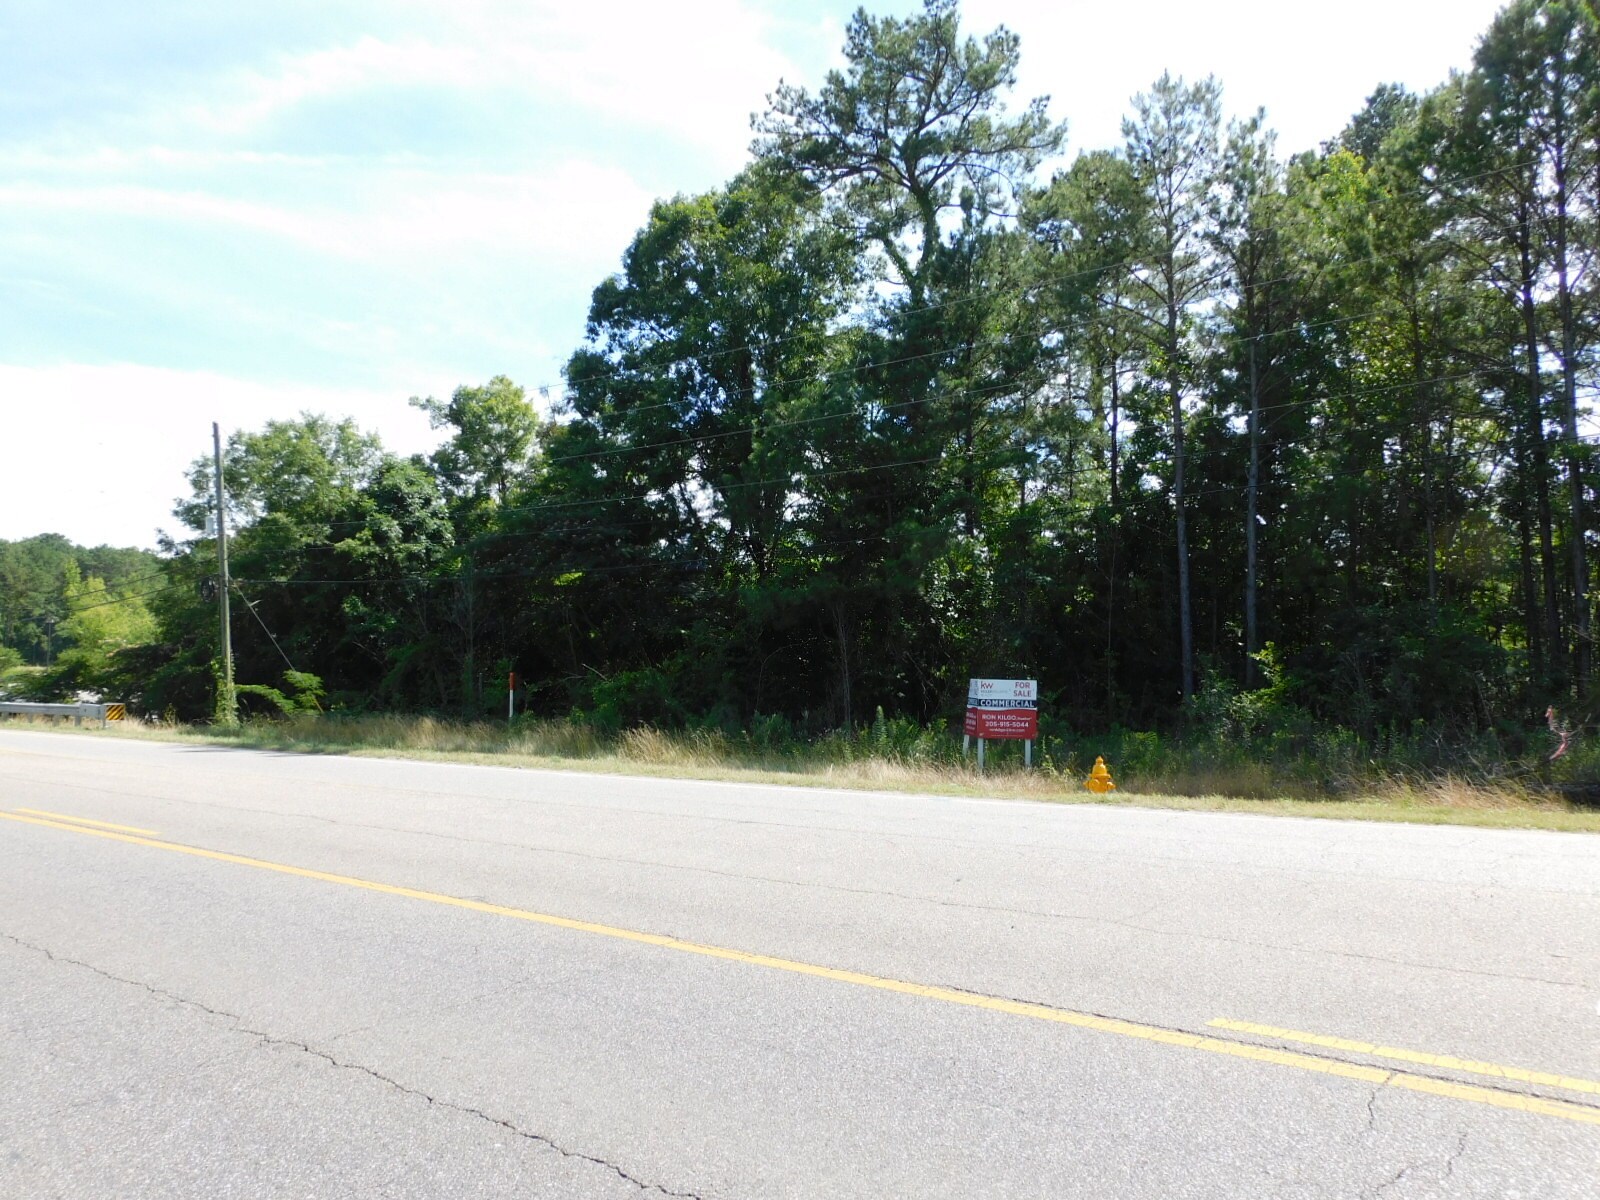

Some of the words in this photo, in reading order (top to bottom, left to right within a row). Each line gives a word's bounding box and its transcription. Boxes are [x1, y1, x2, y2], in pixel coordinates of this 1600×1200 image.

[1014, 681, 1031, 689] FOR
[1013, 689, 1032, 697] SALE
[980, 699, 1035, 708] COMMERCIAL
